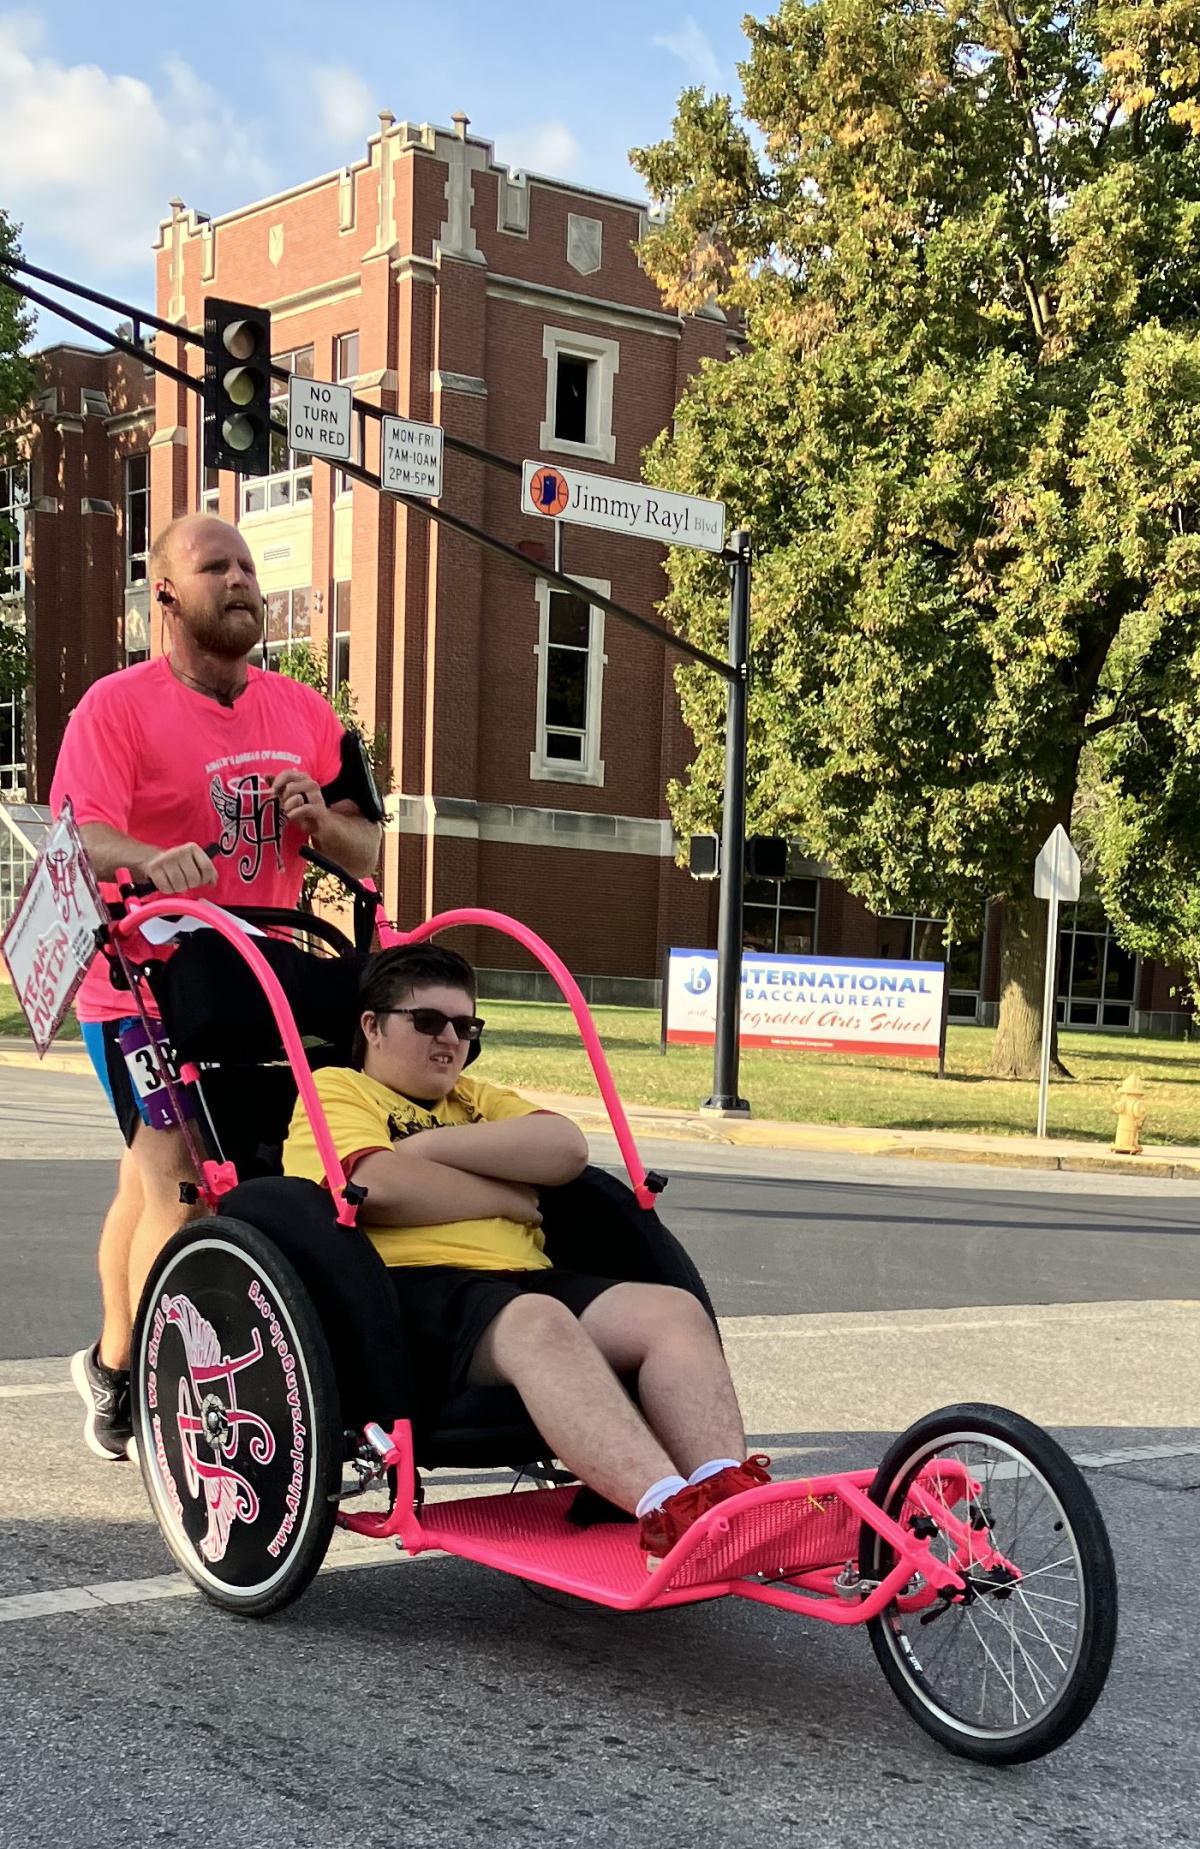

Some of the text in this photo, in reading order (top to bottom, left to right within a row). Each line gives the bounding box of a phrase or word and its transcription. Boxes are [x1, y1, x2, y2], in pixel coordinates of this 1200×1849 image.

[310, 387, 332, 403] NO
[303, 405, 338, 424] TURN
[295, 424, 345, 446] ON RED
[392, 428, 434, 448] MON-FRI
[388, 447, 437, 468] 7AM-10AM
[389, 467, 435, 487] 2PM-5PM
[572, 484, 718, 535] Jimmy Rayl Blvd
[33, 925, 69, 1036] JUSTIN
[745, 989, 907, 1009] BACCALAUREATE
[817, 1010, 861, 1030] Arts
[870, 1012, 932, 1033] School
[247, 1279, 307, 1558] www.AinsleysAngels.org
